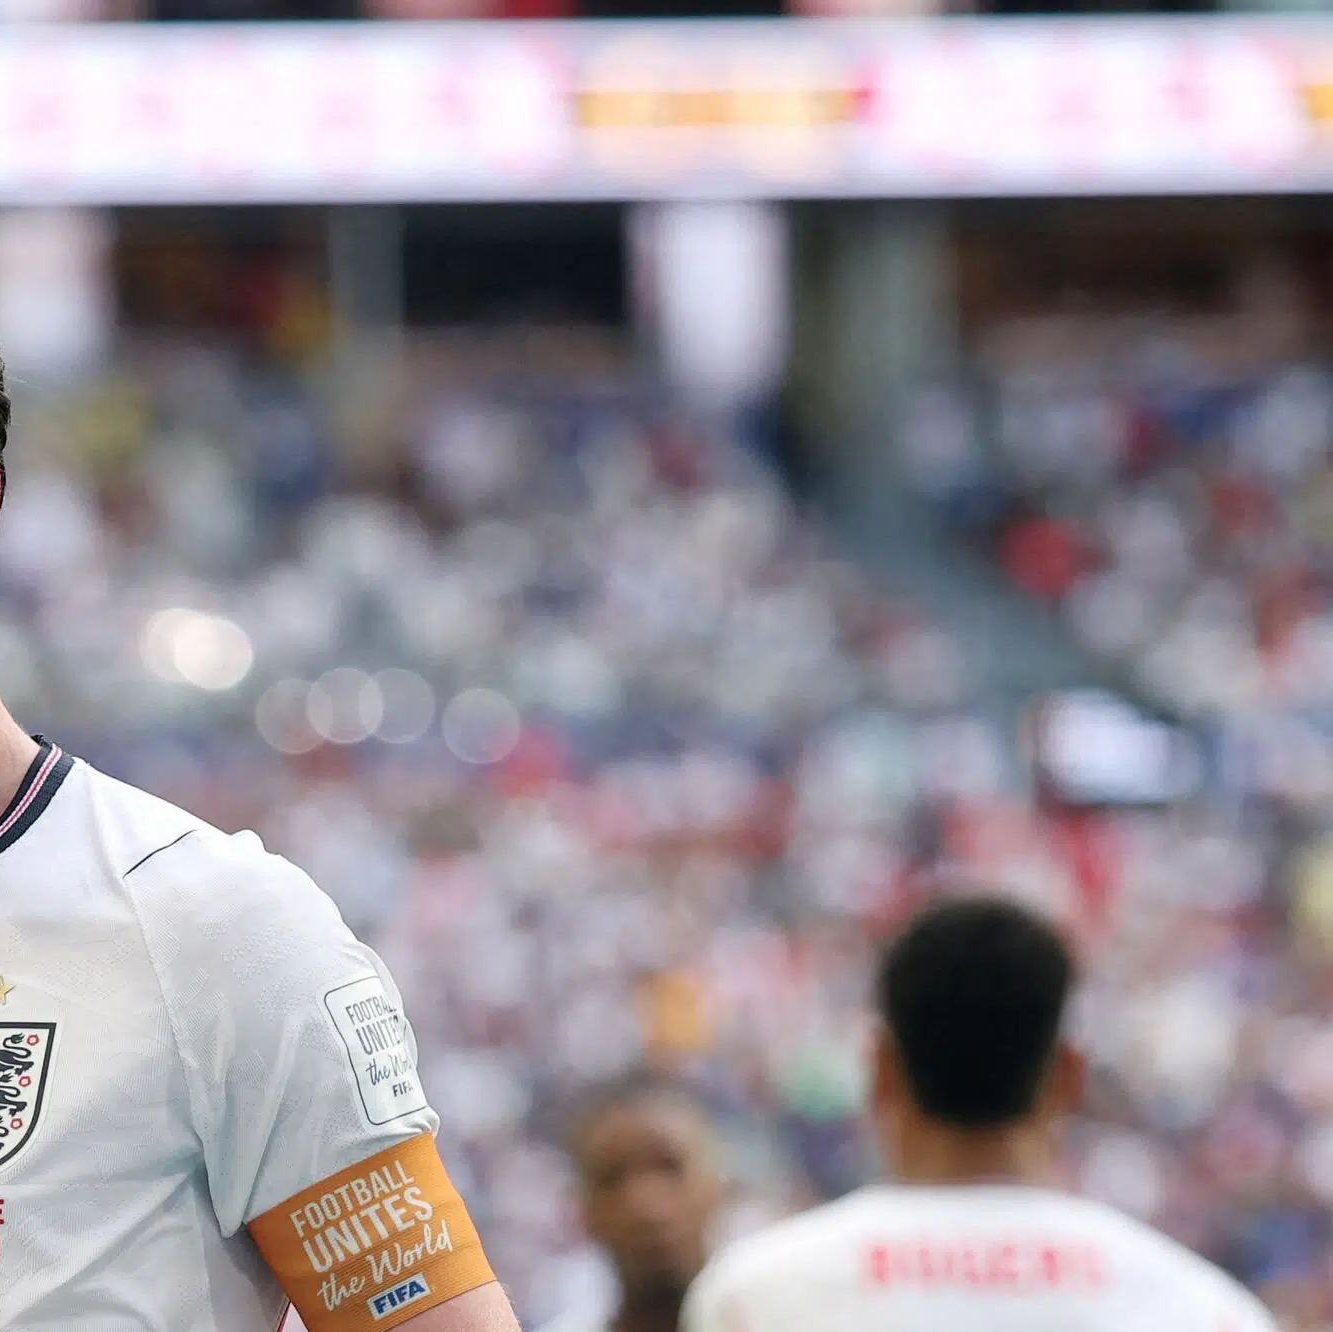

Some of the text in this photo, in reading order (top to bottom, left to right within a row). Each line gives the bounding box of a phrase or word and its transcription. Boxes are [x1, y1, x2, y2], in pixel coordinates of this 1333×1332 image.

[365, 1058, 391, 1086] the
[289, 1160, 416, 1238] FOOTBALL
[301, 1185, 433, 1273] UNITES
[317, 1222, 454, 1312] the World
[371, 1281, 429, 1315] FIFA
